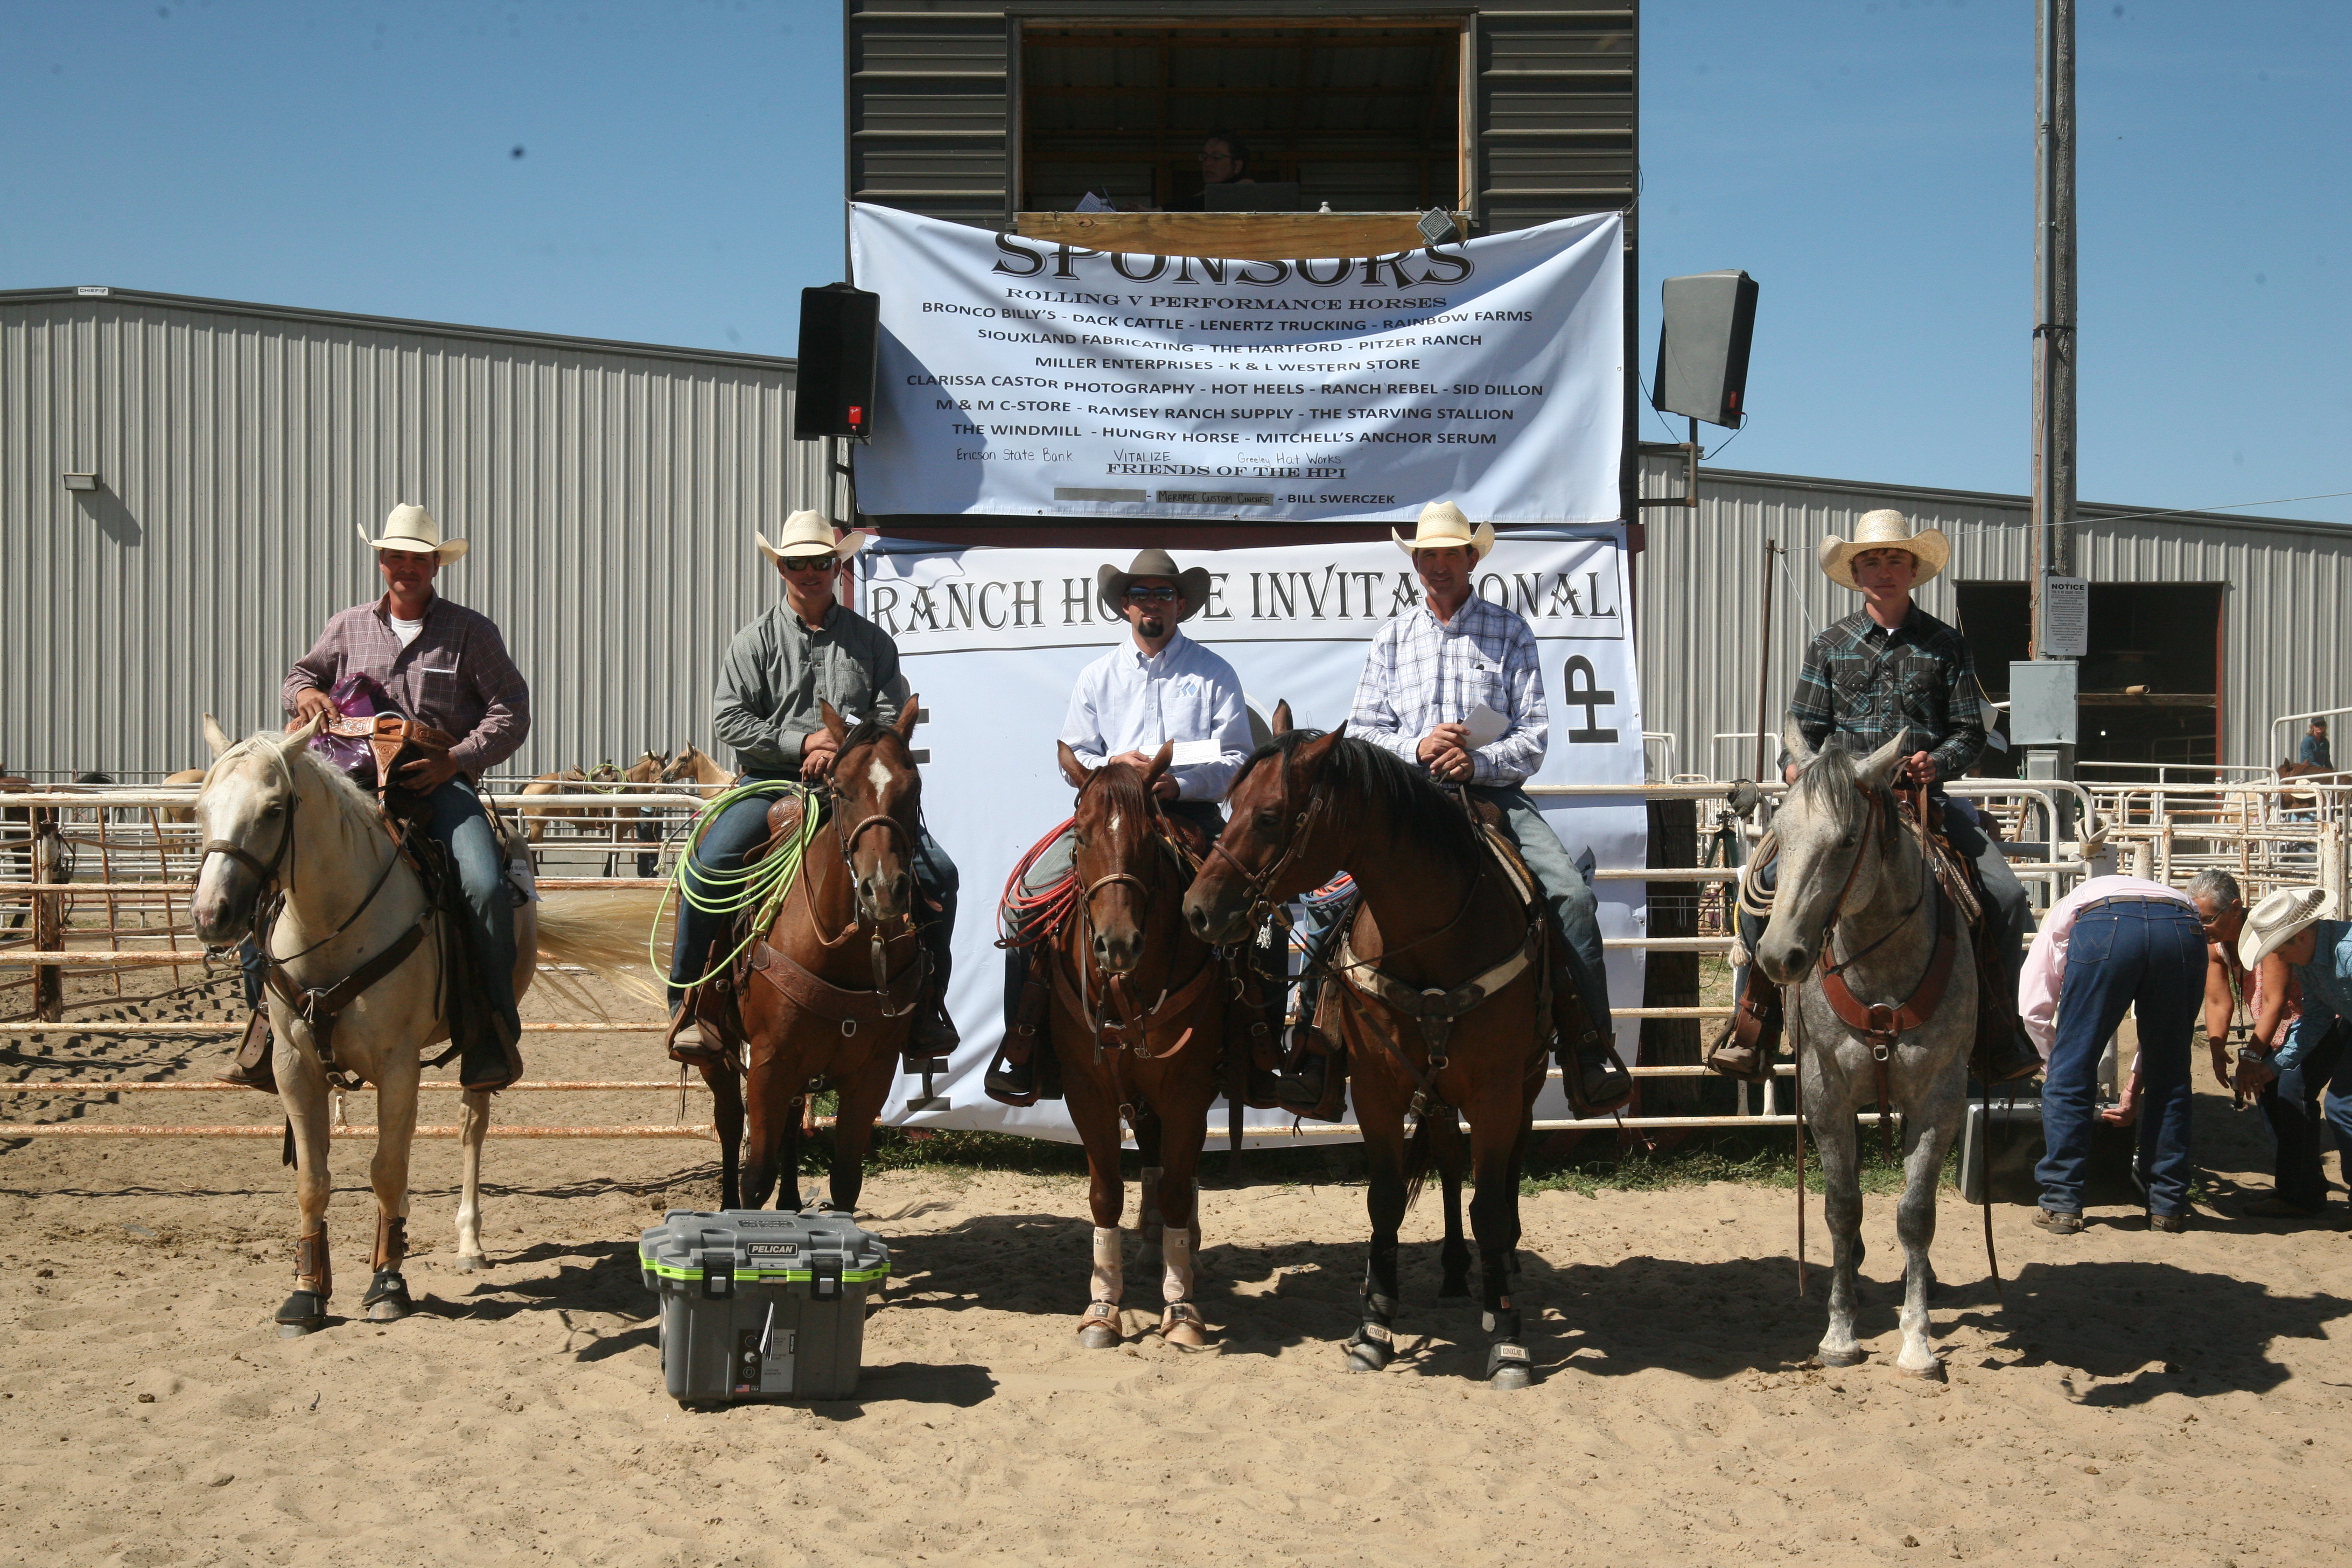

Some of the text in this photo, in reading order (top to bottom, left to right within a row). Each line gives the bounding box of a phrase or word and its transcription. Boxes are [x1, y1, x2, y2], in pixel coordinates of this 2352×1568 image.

[991, 232, 1475, 291] SPONSORS
[1005, 288, 1447, 310] ROLLING V PERFORMANCE HORSES
[922, 302, 997, 319] BRONCO
[1073, 314, 1118, 327] DACK
[1124, 317, 1184, 330] CATTLE
[1200, 320, 1273, 331] LENERTZ
[1278, 320, 1366, 331] TRUCKING
[1383, 312, 1469, 329] RAINBOW
[1474, 311, 1532, 321] FARMS
[978, 328, 1077, 345] SIOUXLAND
[1082, 334, 1194, 352] FABRICATING
[1210, 345, 1242, 353] THE
[1248, 342, 1342, 353] HARTFORD
[1359, 338, 1416, 351] PITZER
[1422, 334, 1482, 346] RANCH
[1035, 356, 1097, 369] MILLER
[1102, 357, 1213, 370] ENTERPRISES
[1229, 362, 1240, 370] K
[1245, 362, 1259, 370] &
[1265, 363, 1273, 371] L
[1278, 361, 1361, 373] WESTERN
[1366, 359, 1420, 370] STORE
[907, 375, 986, 386] CLARISSA
[991, 375, 1058, 389] CASTOR
[1064, 381, 1195, 394] PHOTOGRAPHY
[1212, 383, 1248, 395] HOT
[1254, 383, 1305, 395] HEELS
[1321, 383, 1381, 395] RANCH
[1387, 383, 1438, 395] REBEL
[1453, 384, 1479, 395] SID
[1485, 384, 1543, 396] DILLON
[936, 400, 952, 410] M
[958, 399, 972, 410] &
[977, 400, 994, 411] M
[999, 400, 1071, 412] C-STORE
[1088, 404, 1160, 419] RAMSEY
[1164, 408, 1225, 419] RANCH
[1230, 408, 1293, 419] SUPPLY
[1309, 408, 1342, 419] THE
[1347, 408, 1432, 419] STARVING
[1437, 409, 1513, 420] STALLION
[952, 424, 985, 435] THE
[990, 424, 1082, 437] WINDMILL
[1102, 426, 1177, 442] HUNGRY
[1182, 432, 1240, 444] HORSE
[1359, 432, 1432, 443] ANCHOR
[1437, 433, 1496, 444] SERUM
[956, 446, 1074, 463] Ericson State Bank
[1237, 452, 1342, 467] Greeley Hat Works
[1106, 463, 1347, 479] FRIENDS OF THE HPI
[1287, 494, 1315, 503] BILL
[1320, 494, 1395, 504] SWERCZEK
[870, 580, 1046, 639] RANCH
[1250, 562, 1618, 620] INVITAONAL
